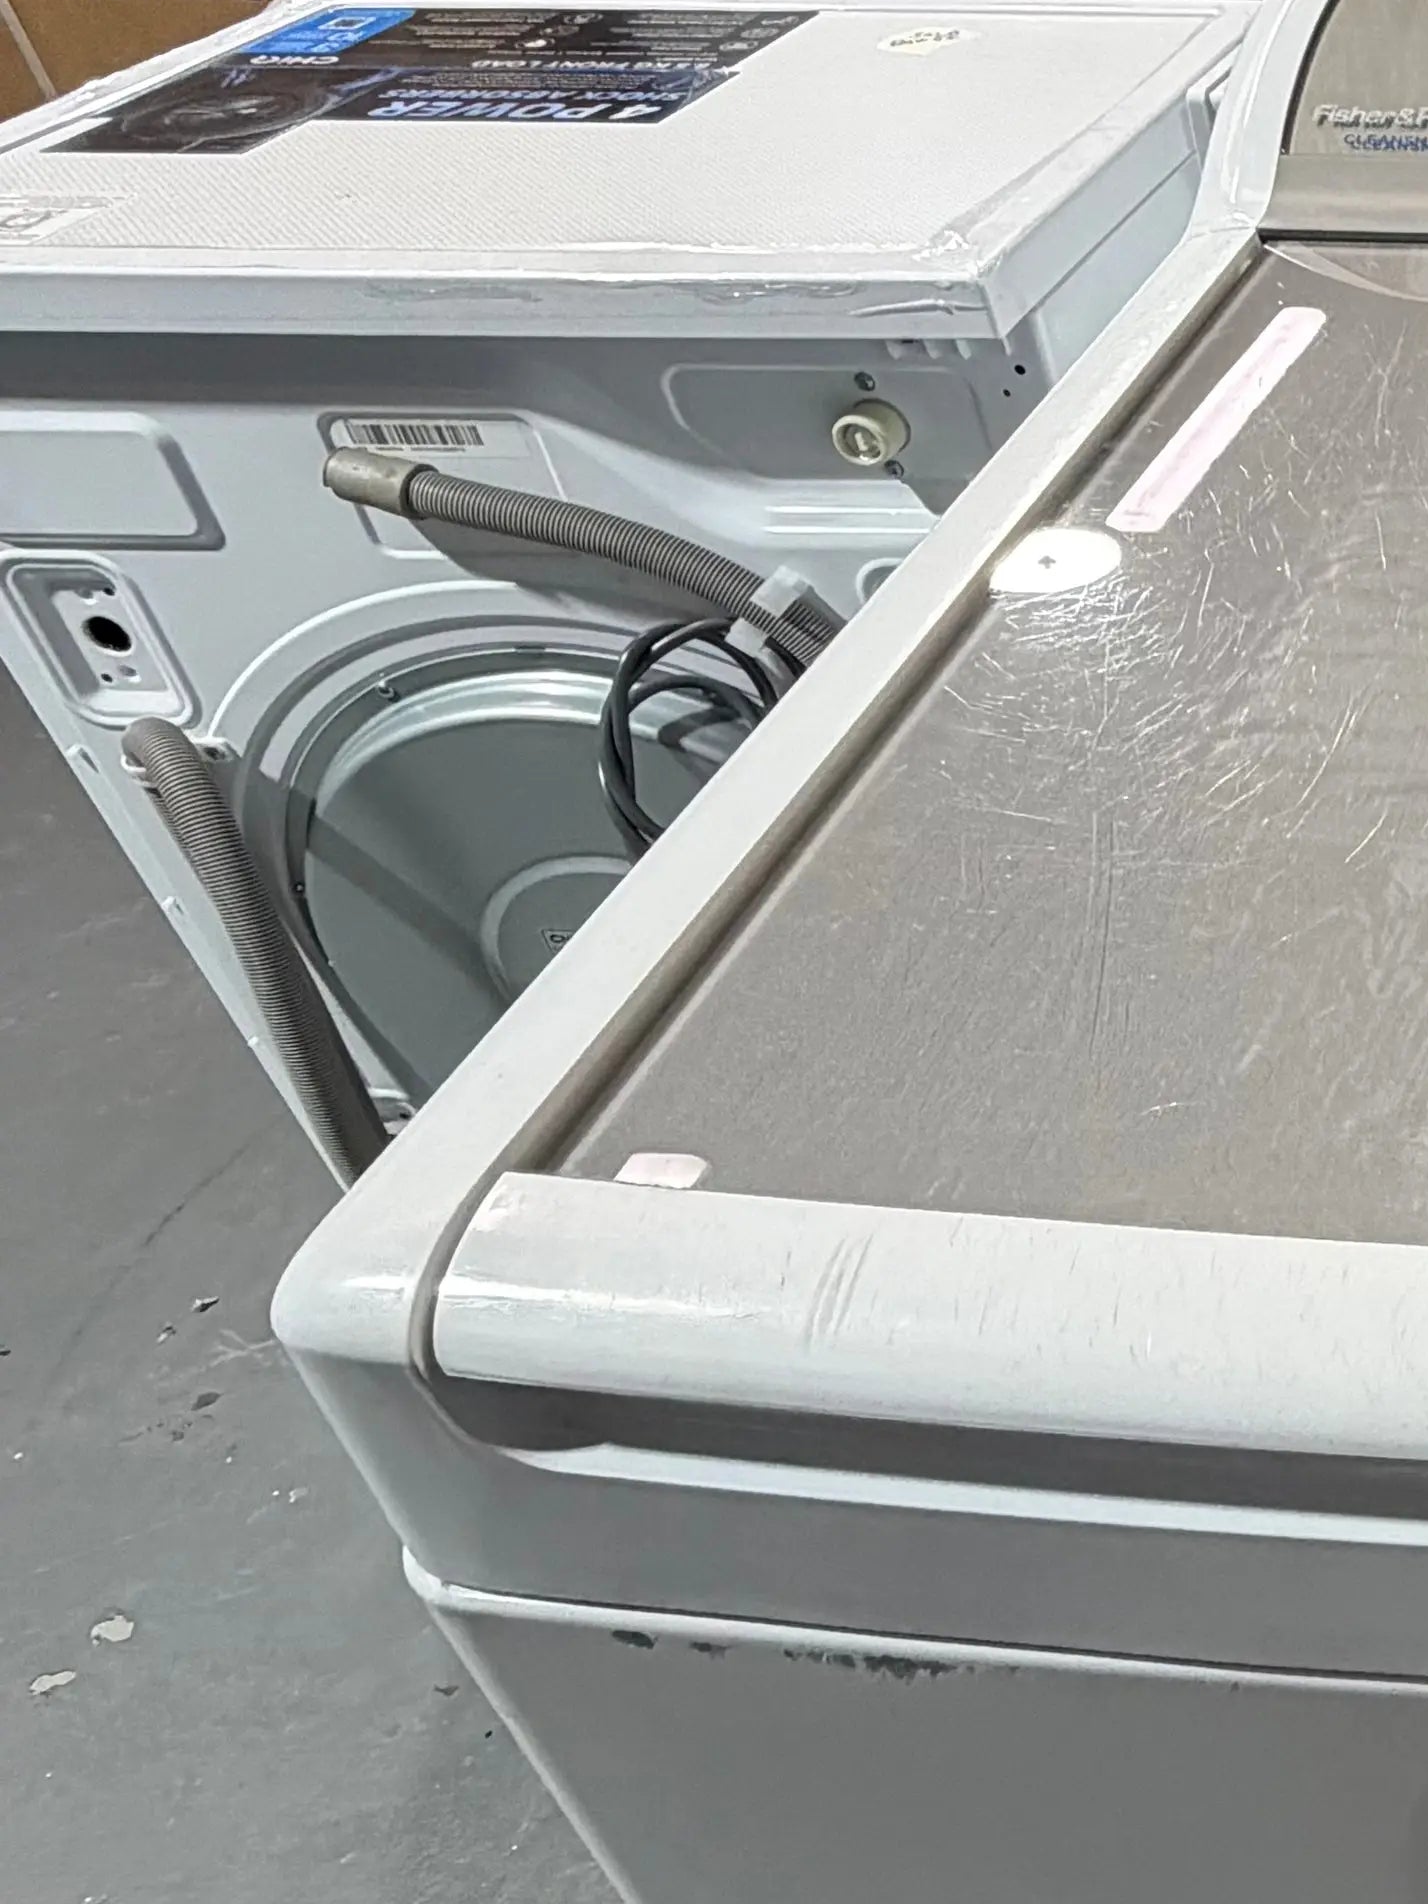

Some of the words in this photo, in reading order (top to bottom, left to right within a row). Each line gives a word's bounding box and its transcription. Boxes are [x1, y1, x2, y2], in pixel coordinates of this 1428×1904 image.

[379, 88, 577, 100] ABSORBERS
[576, 90, 687, 101] SHOCK
[367, 101, 612, 120] POWER
[608, 104, 661, 120] 4
